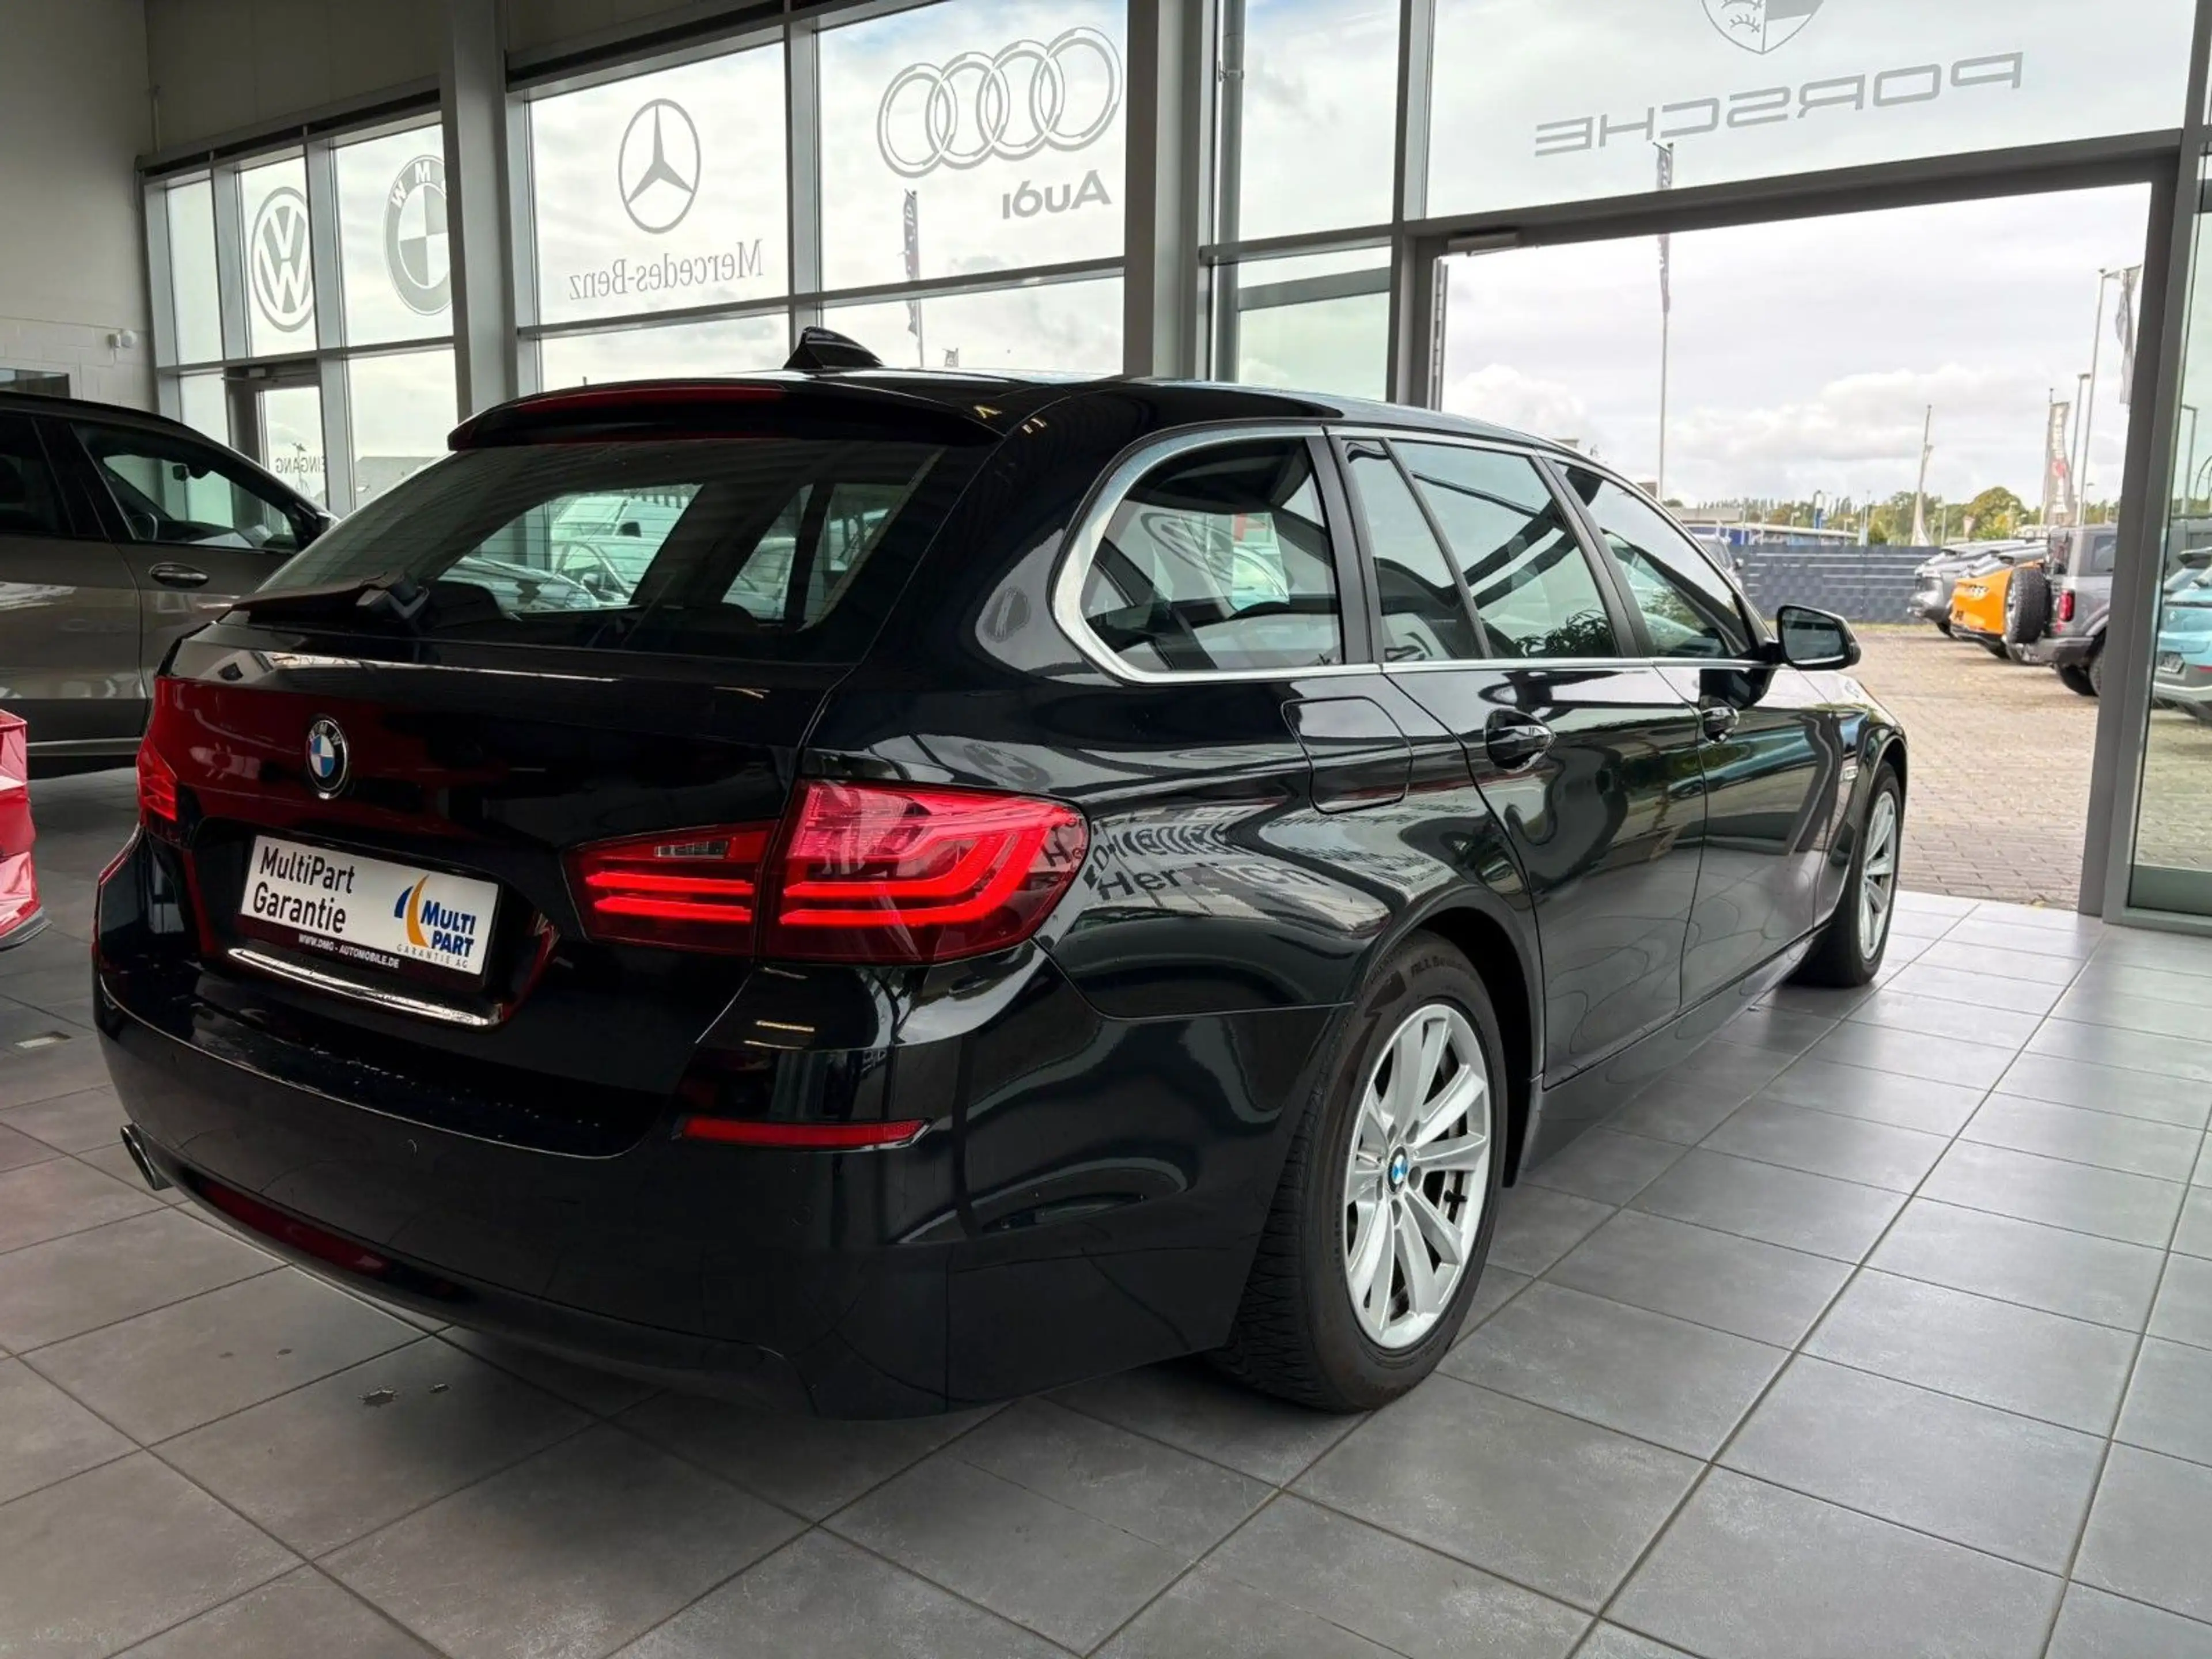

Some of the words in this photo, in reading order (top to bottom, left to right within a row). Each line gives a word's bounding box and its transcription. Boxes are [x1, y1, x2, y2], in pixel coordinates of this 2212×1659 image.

[260, 846, 355, 894] MultiPart
[253, 881, 346, 933] Garantie
[396, 943, 450, 965] GARANTIE
[456, 959, 468, 969] AG
[431, 930, 474, 957] PART
